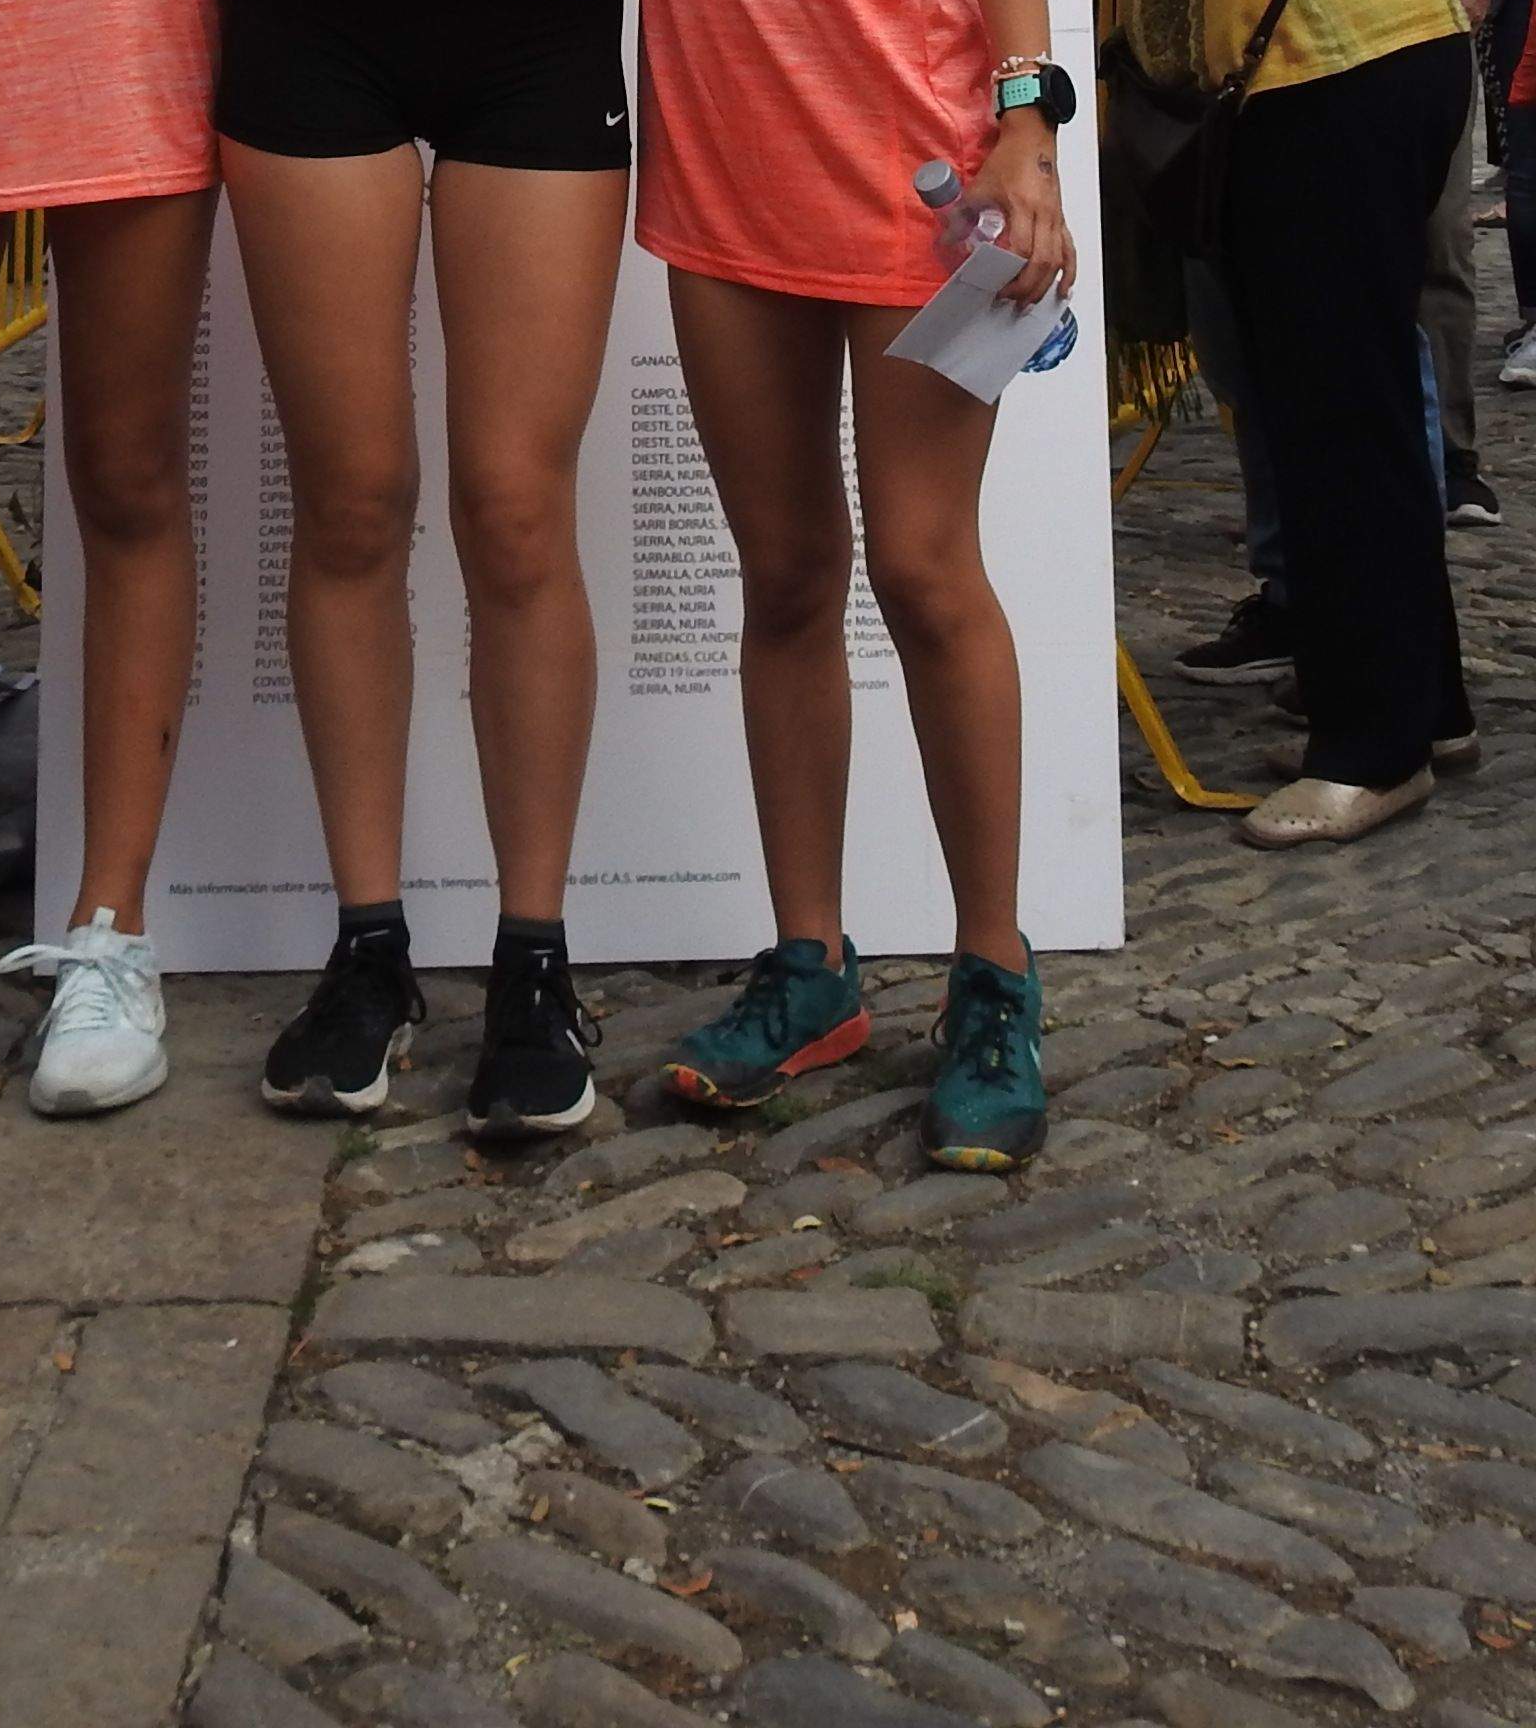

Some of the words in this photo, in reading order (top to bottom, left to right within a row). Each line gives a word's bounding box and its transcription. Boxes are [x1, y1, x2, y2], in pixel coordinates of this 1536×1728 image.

[631, 388, 677, 399] CAMPO,
[632, 404, 674, 416] DIESTE,
[632, 421, 674, 432] DIESTE,
[632, 437, 674, 448] DIESTE,
[632, 453, 674, 465] DIESTE,
[632, 470, 674, 481] SIERRA,
[632, 503, 675, 514] SIERRA,
[678, 503, 714, 513] NURIA
[633, 535, 675, 547] SIERRA,
[678, 535, 715, 546] NURIA
[633, 585, 675, 597] SIERRA,
[679, 585, 715, 595] NURIA
[633, 602, 675, 613] SIERRA,
[679, 602, 715, 612] NURIA
[633, 619, 675, 630] SIERRA,
[679, 618, 716, 629] NURIA
[694, 651, 727, 662] CUCA
[857, 647, 895, 659] Cuarte
[628, 667, 666, 678] COVID
[671, 667, 683, 677] 19
[629, 684, 671, 695] SIERRA,
[675, 683, 711, 693] NURIA
[579, 874, 598, 885] del
